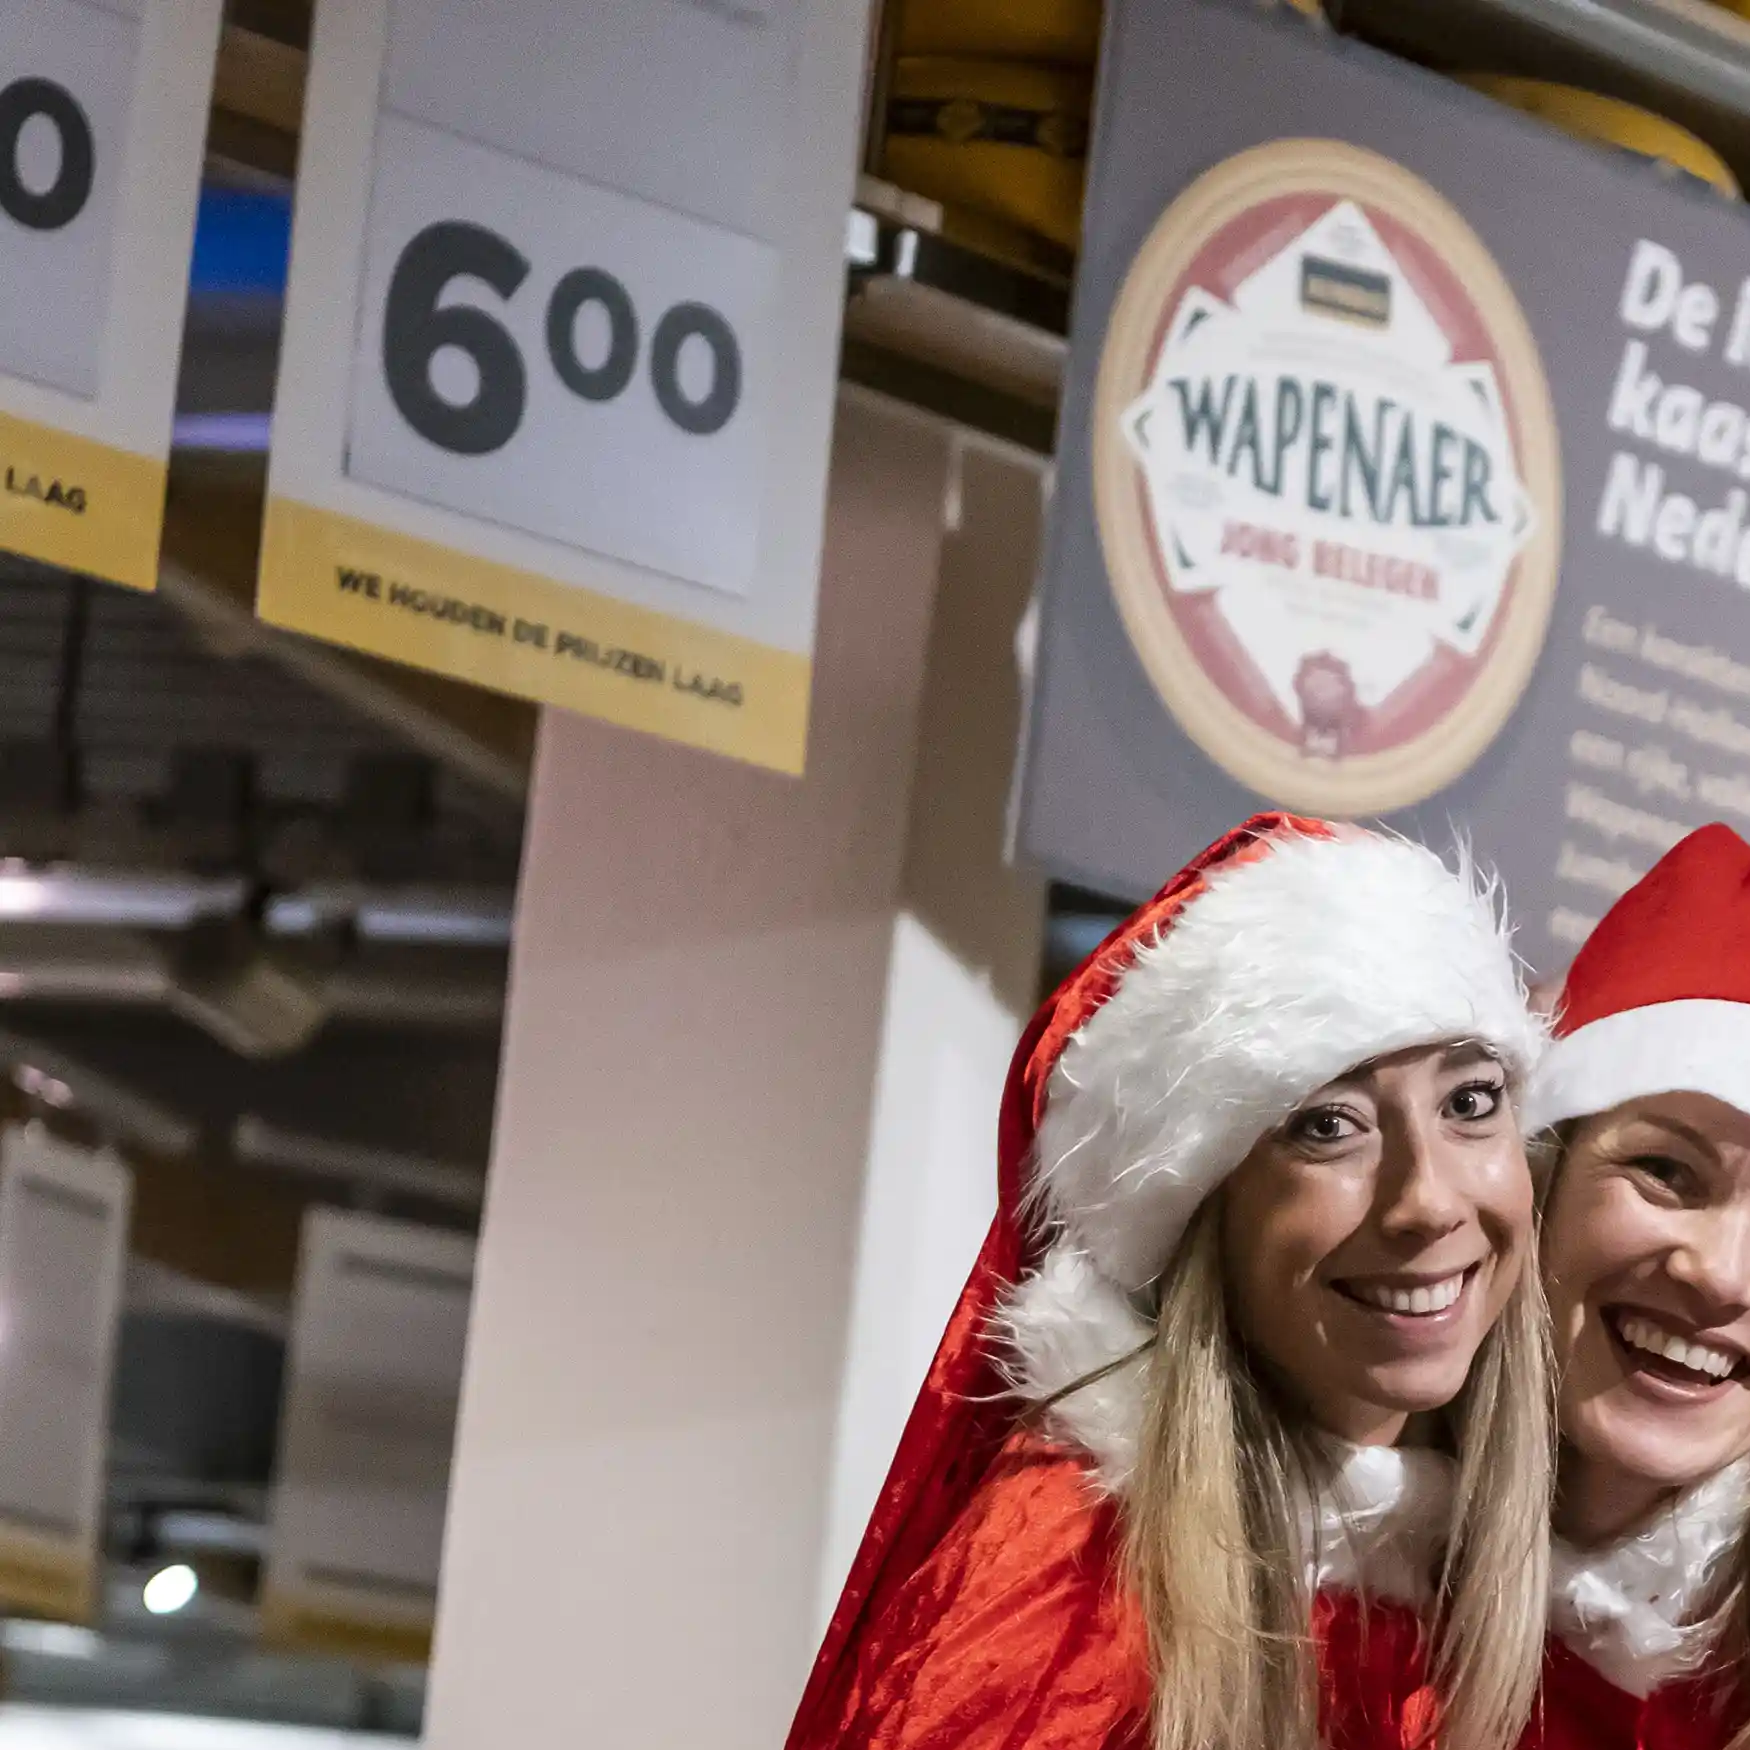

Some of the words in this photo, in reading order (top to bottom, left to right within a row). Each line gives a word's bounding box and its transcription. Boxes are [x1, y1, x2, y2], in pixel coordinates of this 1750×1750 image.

[1619, 239, 1719, 350] De
[5, 466, 86, 513] LAAG
[1168, 374, 1502, 527] WAPENAER
[335, 566, 381, 599] WE
[388, 581, 506, 636] HOUDEN
[513, 617, 549, 649] DE
[673, 664, 745, 707] LAAG
